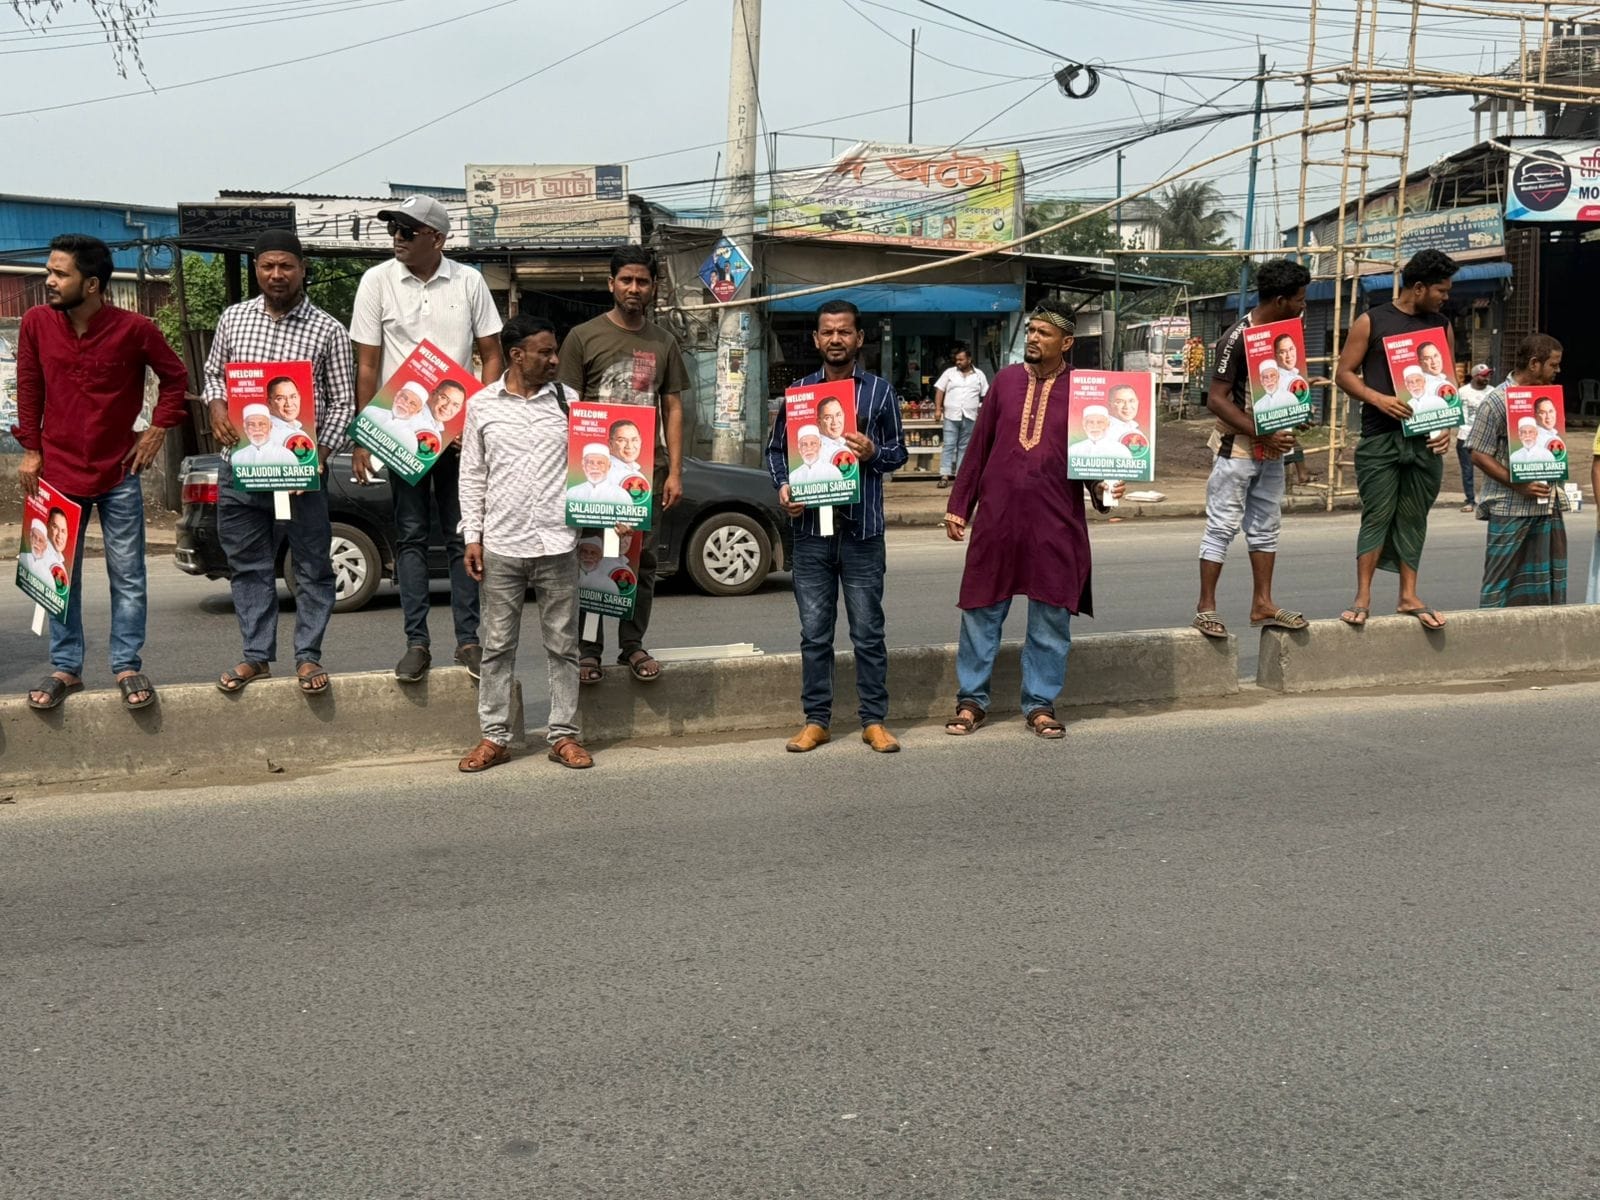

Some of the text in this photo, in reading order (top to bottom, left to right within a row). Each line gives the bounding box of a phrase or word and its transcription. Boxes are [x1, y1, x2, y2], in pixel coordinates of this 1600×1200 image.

[418, 346, 450, 373] WELCOME
[1218, 344, 1233, 373] QUALITY
[229, 370, 264, 378] WELCOME
[572, 409, 608, 419] WELCOME
[1257, 408, 1288, 423] SALAUDDIN
[1289, 402, 1310, 416] SARKER
[357, 417, 398, 452] SALAUDDIN
[395, 446, 425, 473] SARKER
[1071, 457, 1146, 469] SALAUDDIN SARKER
[236, 466, 315, 478] SALAUDDIN SARKER
[792, 480, 856, 496] SALAUDDIN SARKER
[569, 502, 648, 517] SALAUDDIN SARKER
[580, 589, 602, 601] UDDIN
